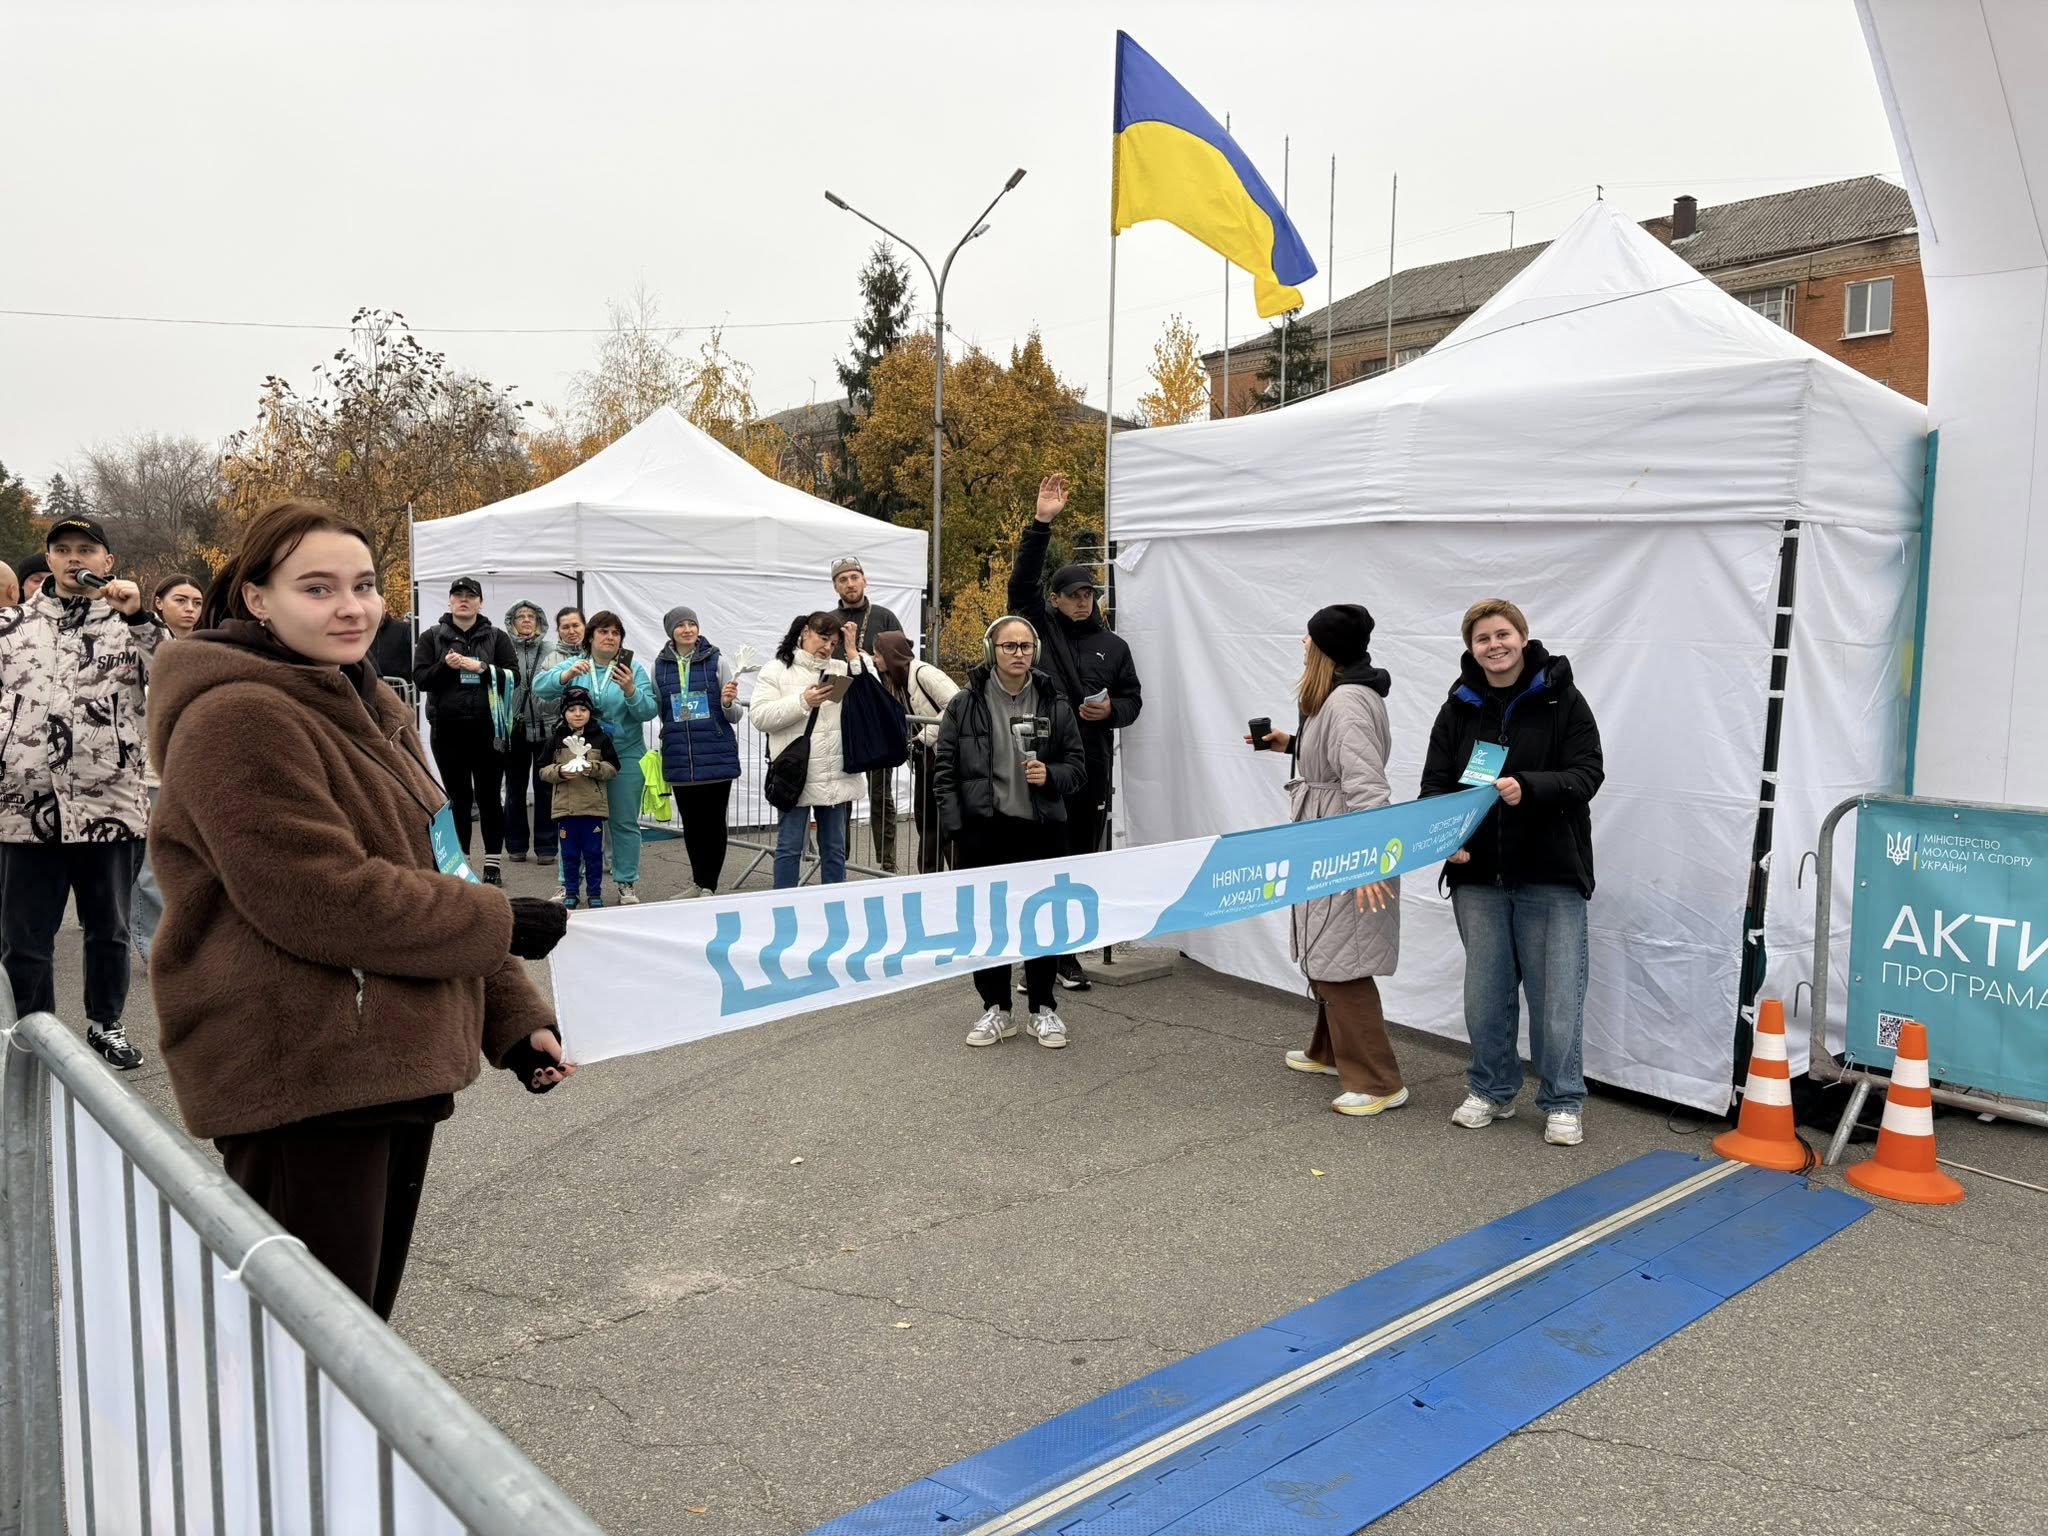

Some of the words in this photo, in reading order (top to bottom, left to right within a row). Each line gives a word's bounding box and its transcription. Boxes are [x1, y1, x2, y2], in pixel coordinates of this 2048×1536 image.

[1923, 834, 2000, 850] МІНІСТЕРСТВО
[1921, 847, 1970, 861] МОЛОДІ
[1972, 852, 1985, 863] ТА
[1987, 854, 2033, 867] СПОРТУ
[1920, 859, 1967, 873] УКРАЇНИ
